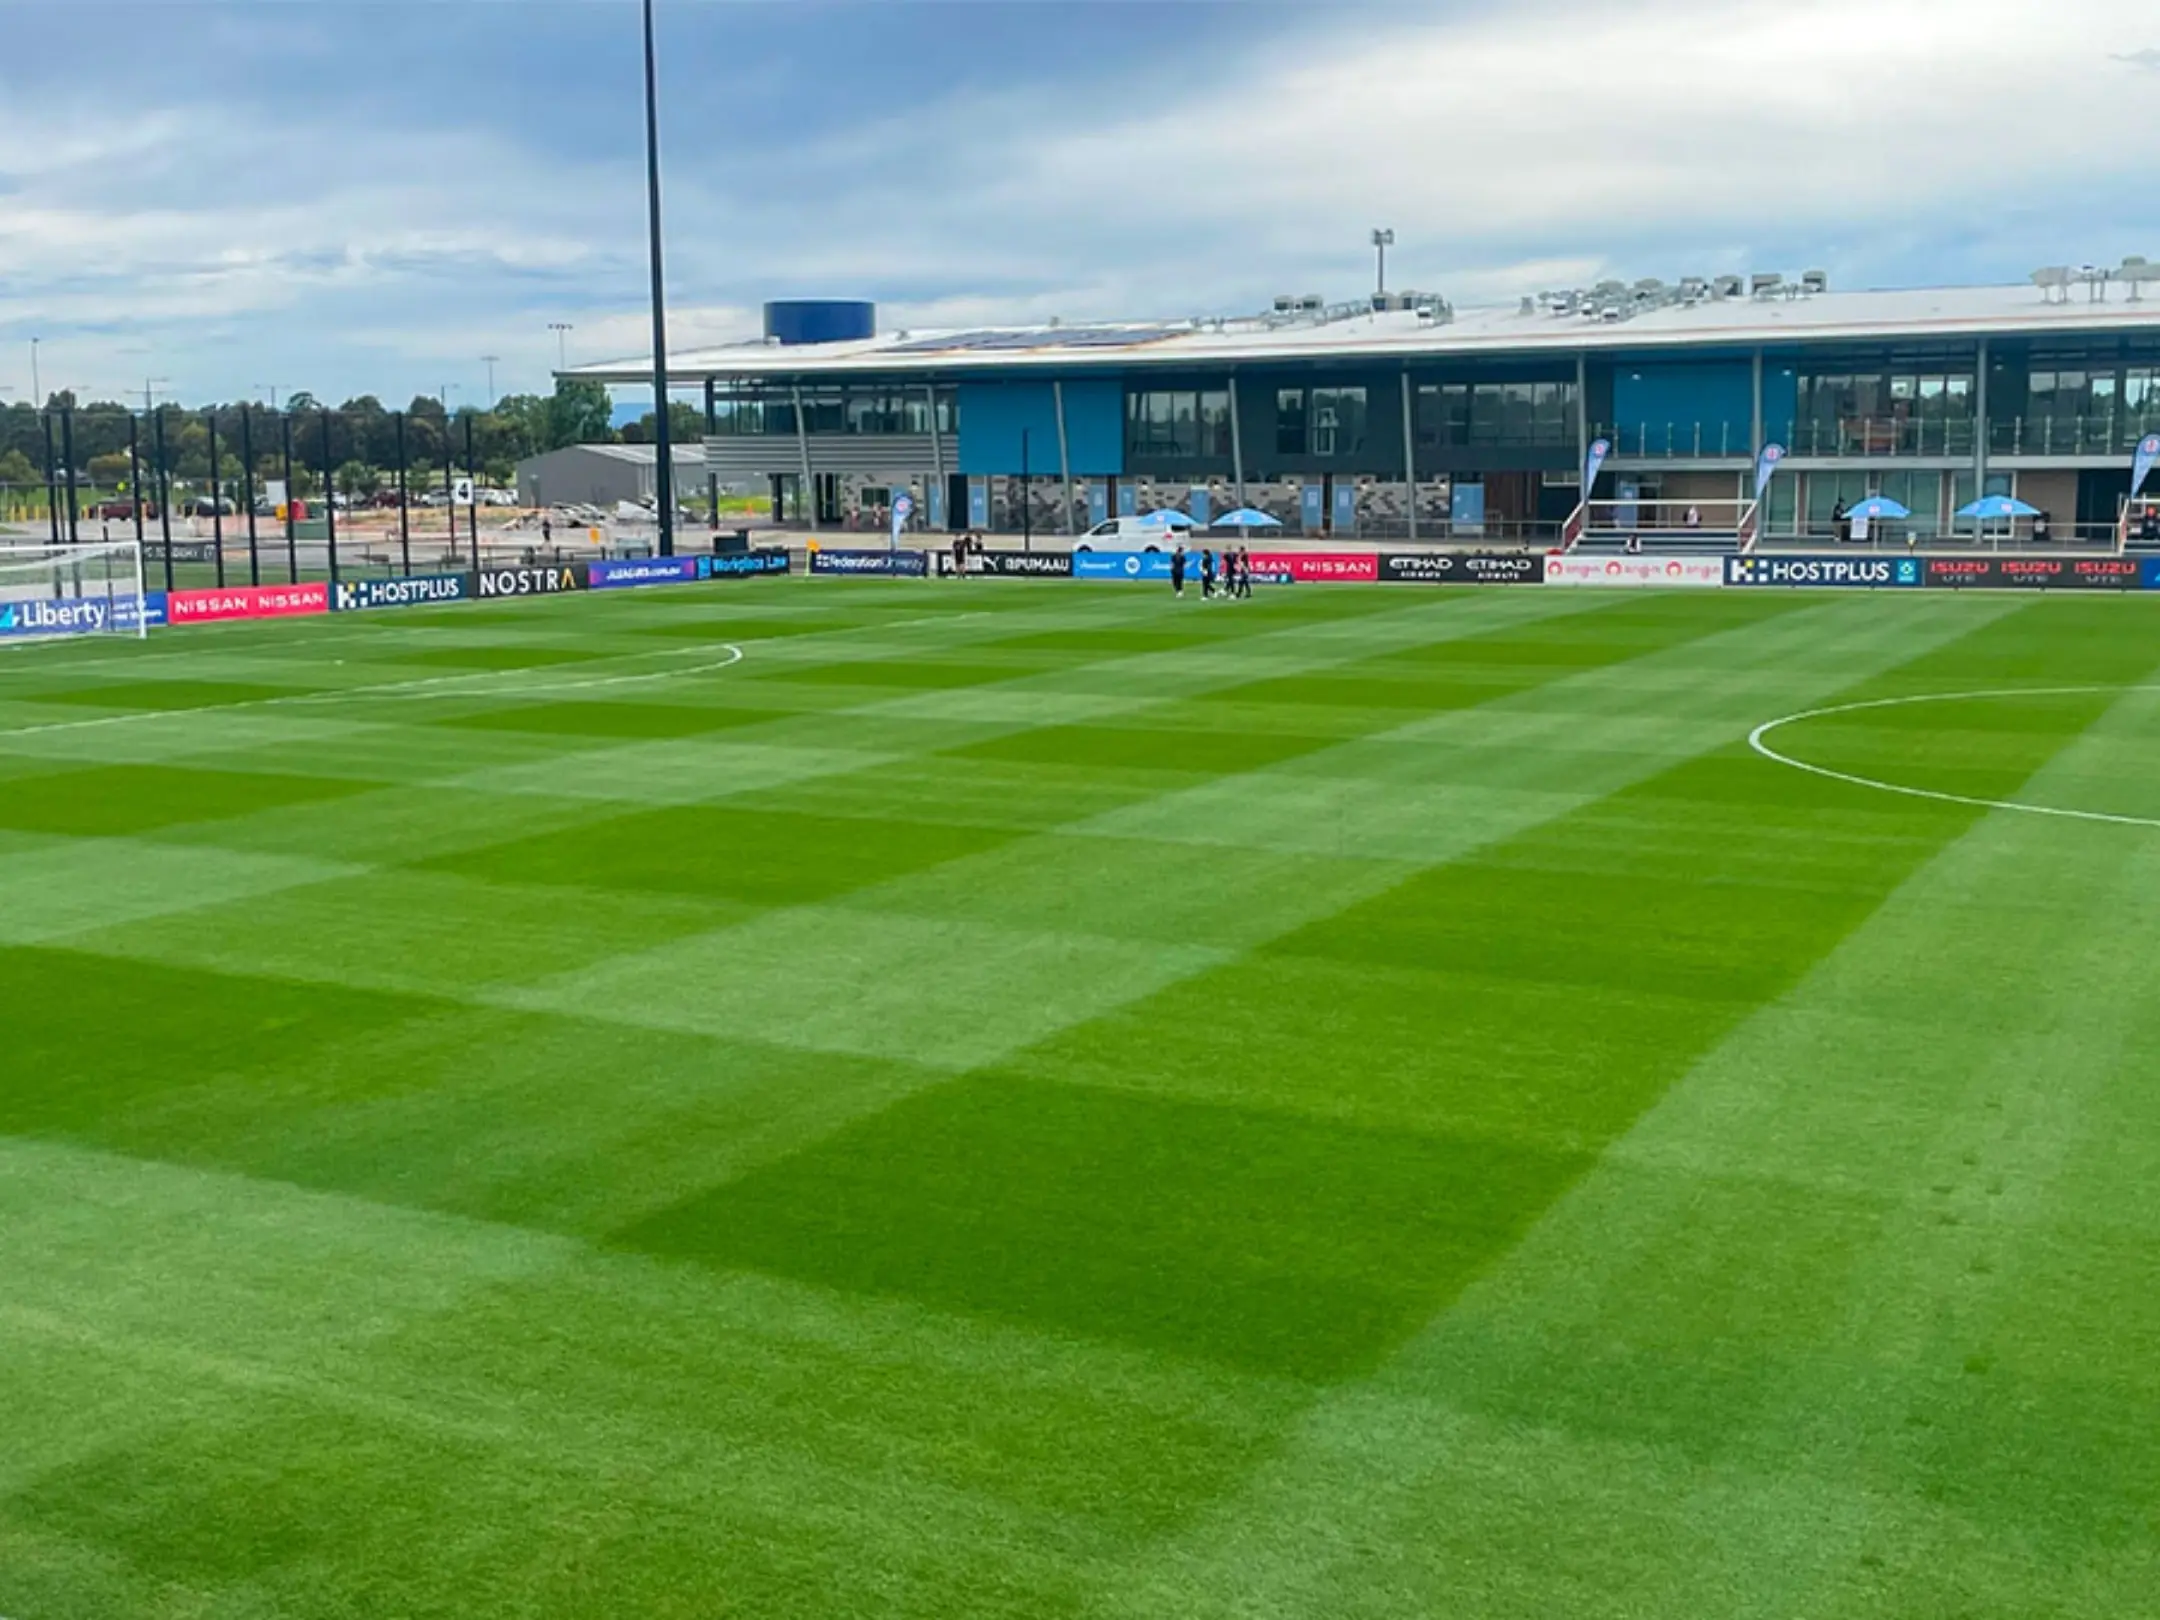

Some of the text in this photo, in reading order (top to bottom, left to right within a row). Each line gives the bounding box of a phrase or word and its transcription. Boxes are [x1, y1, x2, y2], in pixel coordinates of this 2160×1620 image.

[1303, 561, 1372, 573] NISSAN
[1389, 557, 1452, 570] ETIHAD
[1466, 558, 1532, 570] ETIHAD
[1931, 561, 1990, 573] ISUZU
[2001, 561, 2062, 573] ISUZU
[2074, 561, 2136, 574] ISUZU
[1773, 561, 1889, 581] HOSTPLUS
[480, 567, 576, 595] NOSTRA
[371, 578, 459, 603] HOSTPLUS
[174, 599, 248, 613] NISSAN
[258, 592, 324, 608] NISSAN
[23, 601, 105, 628] Liberty
